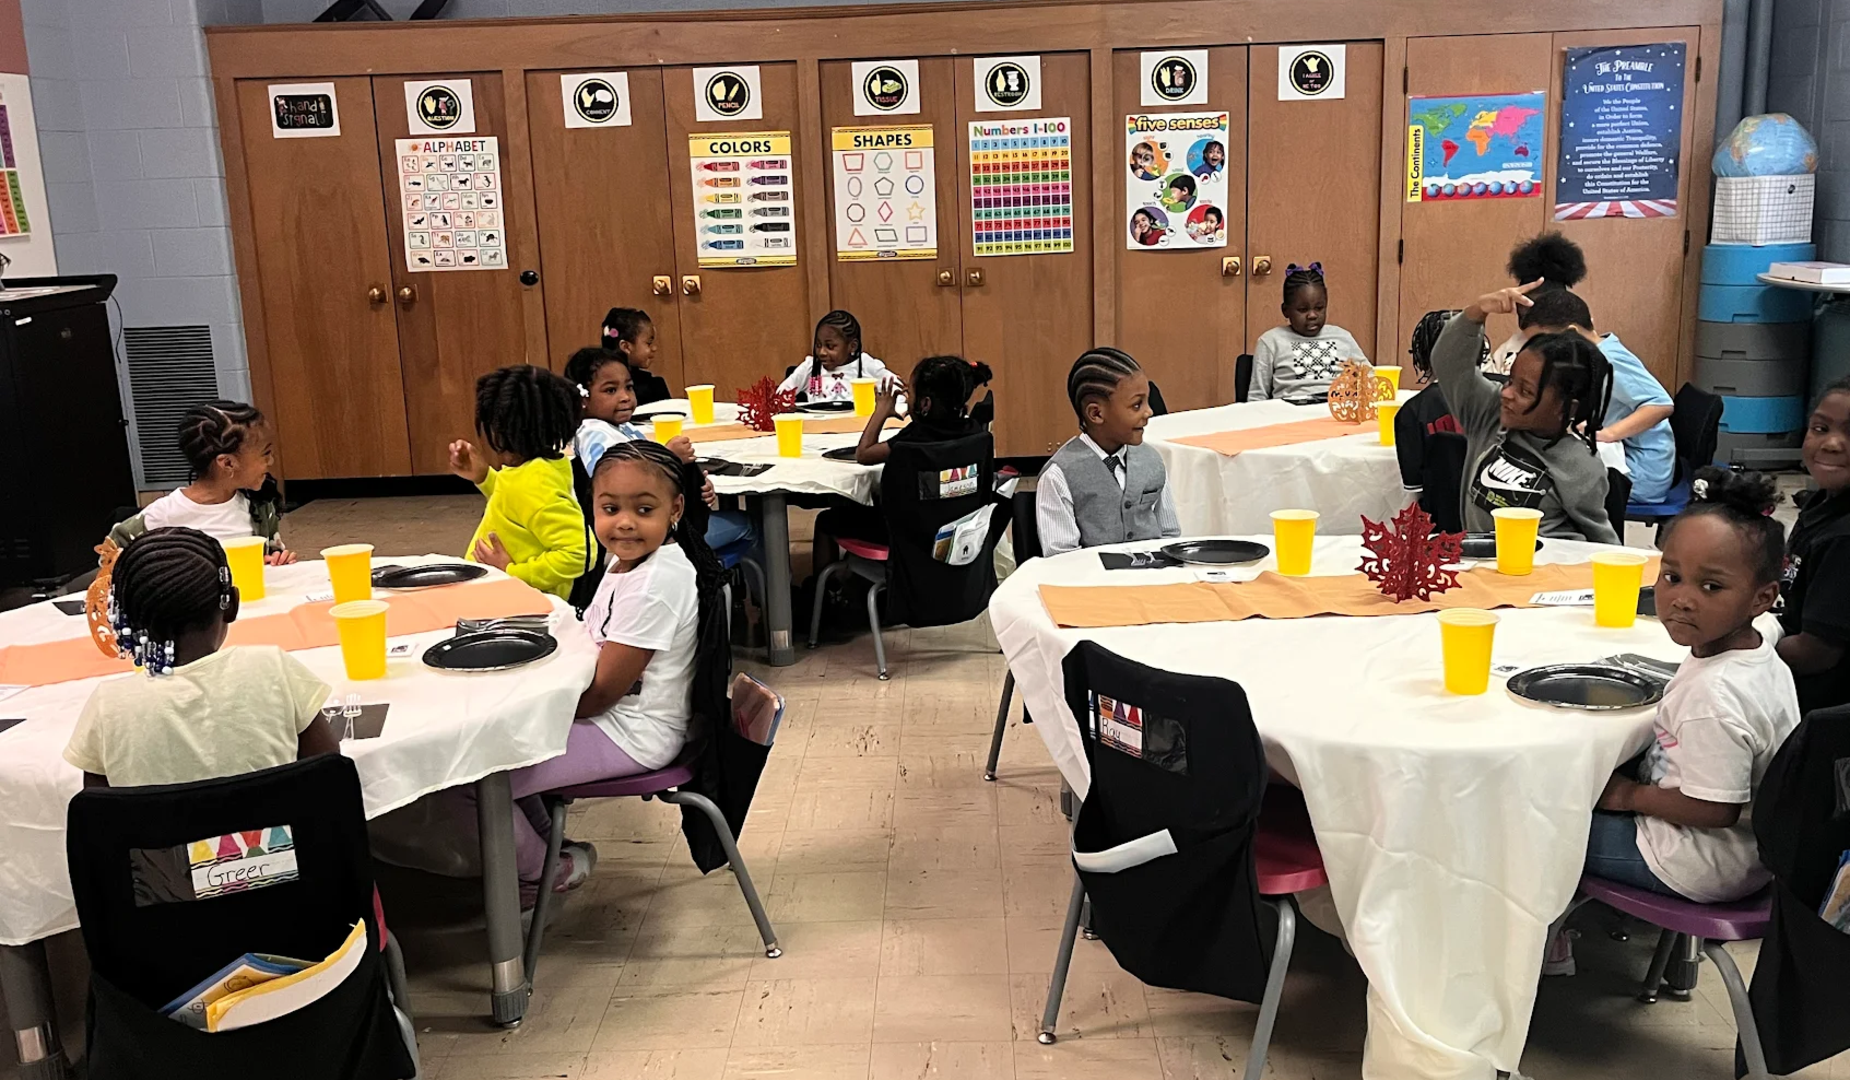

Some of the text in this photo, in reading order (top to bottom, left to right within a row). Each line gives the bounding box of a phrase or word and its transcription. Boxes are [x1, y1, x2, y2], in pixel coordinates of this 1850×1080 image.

[289, 100, 318, 113] hand
[973, 122, 1065, 137] Numbers 1-100
[1135, 116, 1220, 131] five senses
[424, 140, 486, 153] ALPHABET
[710, 140, 771, 154] COLORS
[853, 134, 912, 147] SHAPES
[1410, 128, 1421, 198] The Continents
[1489, 456, 1536, 487] NIKE
[207, 864, 270, 887] Greer
